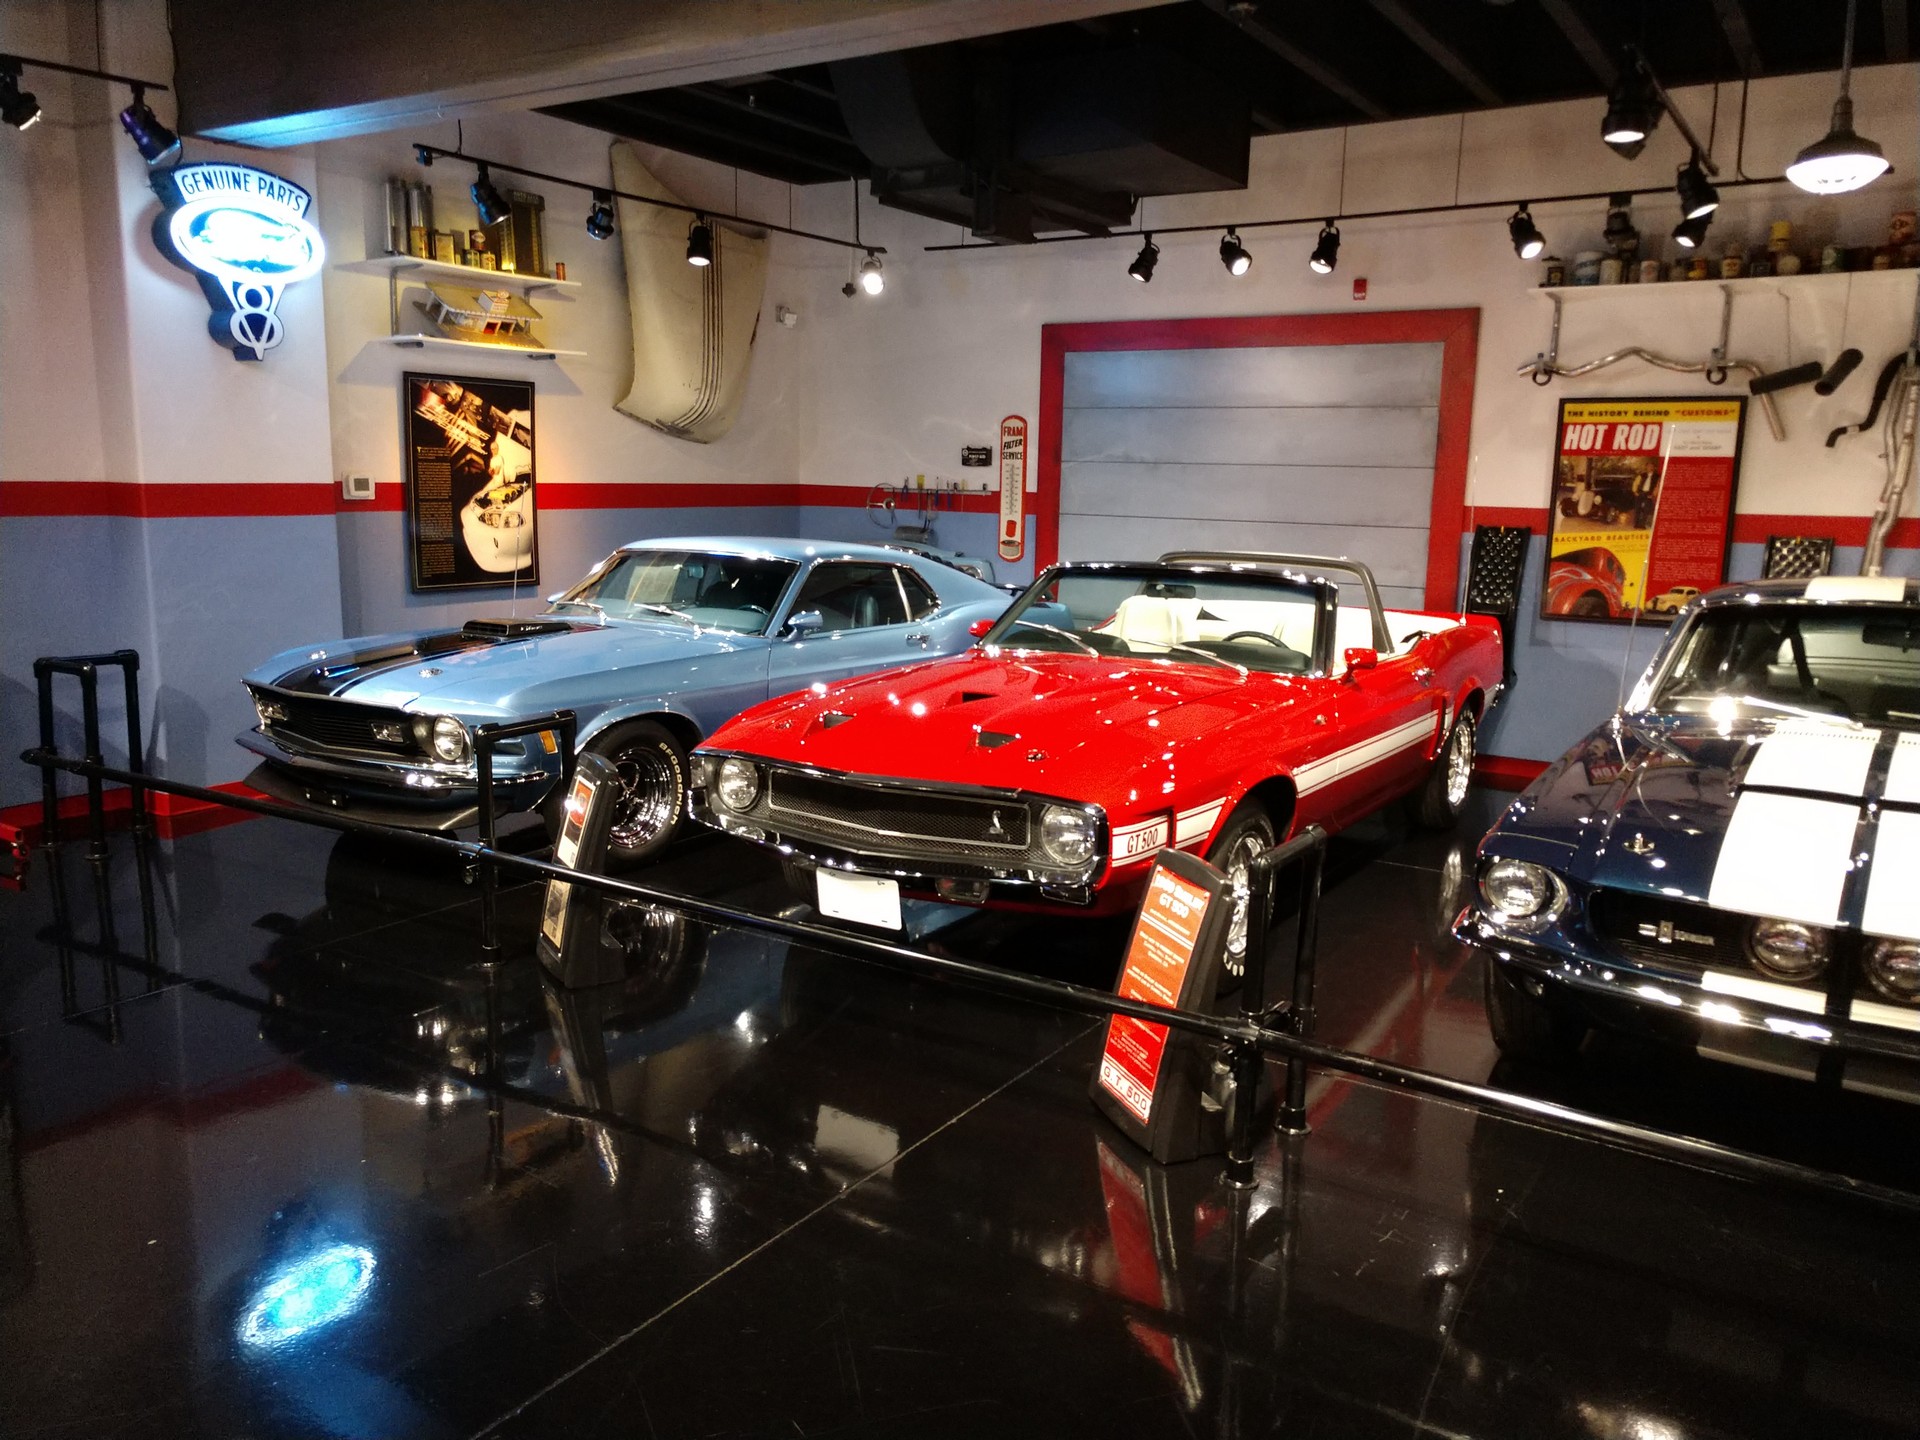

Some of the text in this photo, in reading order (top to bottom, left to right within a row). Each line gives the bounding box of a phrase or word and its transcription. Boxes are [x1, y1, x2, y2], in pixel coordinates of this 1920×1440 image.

[181, 170, 304, 211] GENUINE PARTS
[1003, 426, 1023, 437] FRAM
[1563, 423, 1660, 451] HOT ROD
[1003, 438, 1023, 450] FILTER
[1002, 451, 1023, 460] SERVICE
[1554, 533, 1649, 543] BACKYARD BEAUTIES
[1127, 828, 1159, 854] GT 500
[1126, 1086, 1148, 1111] 500
